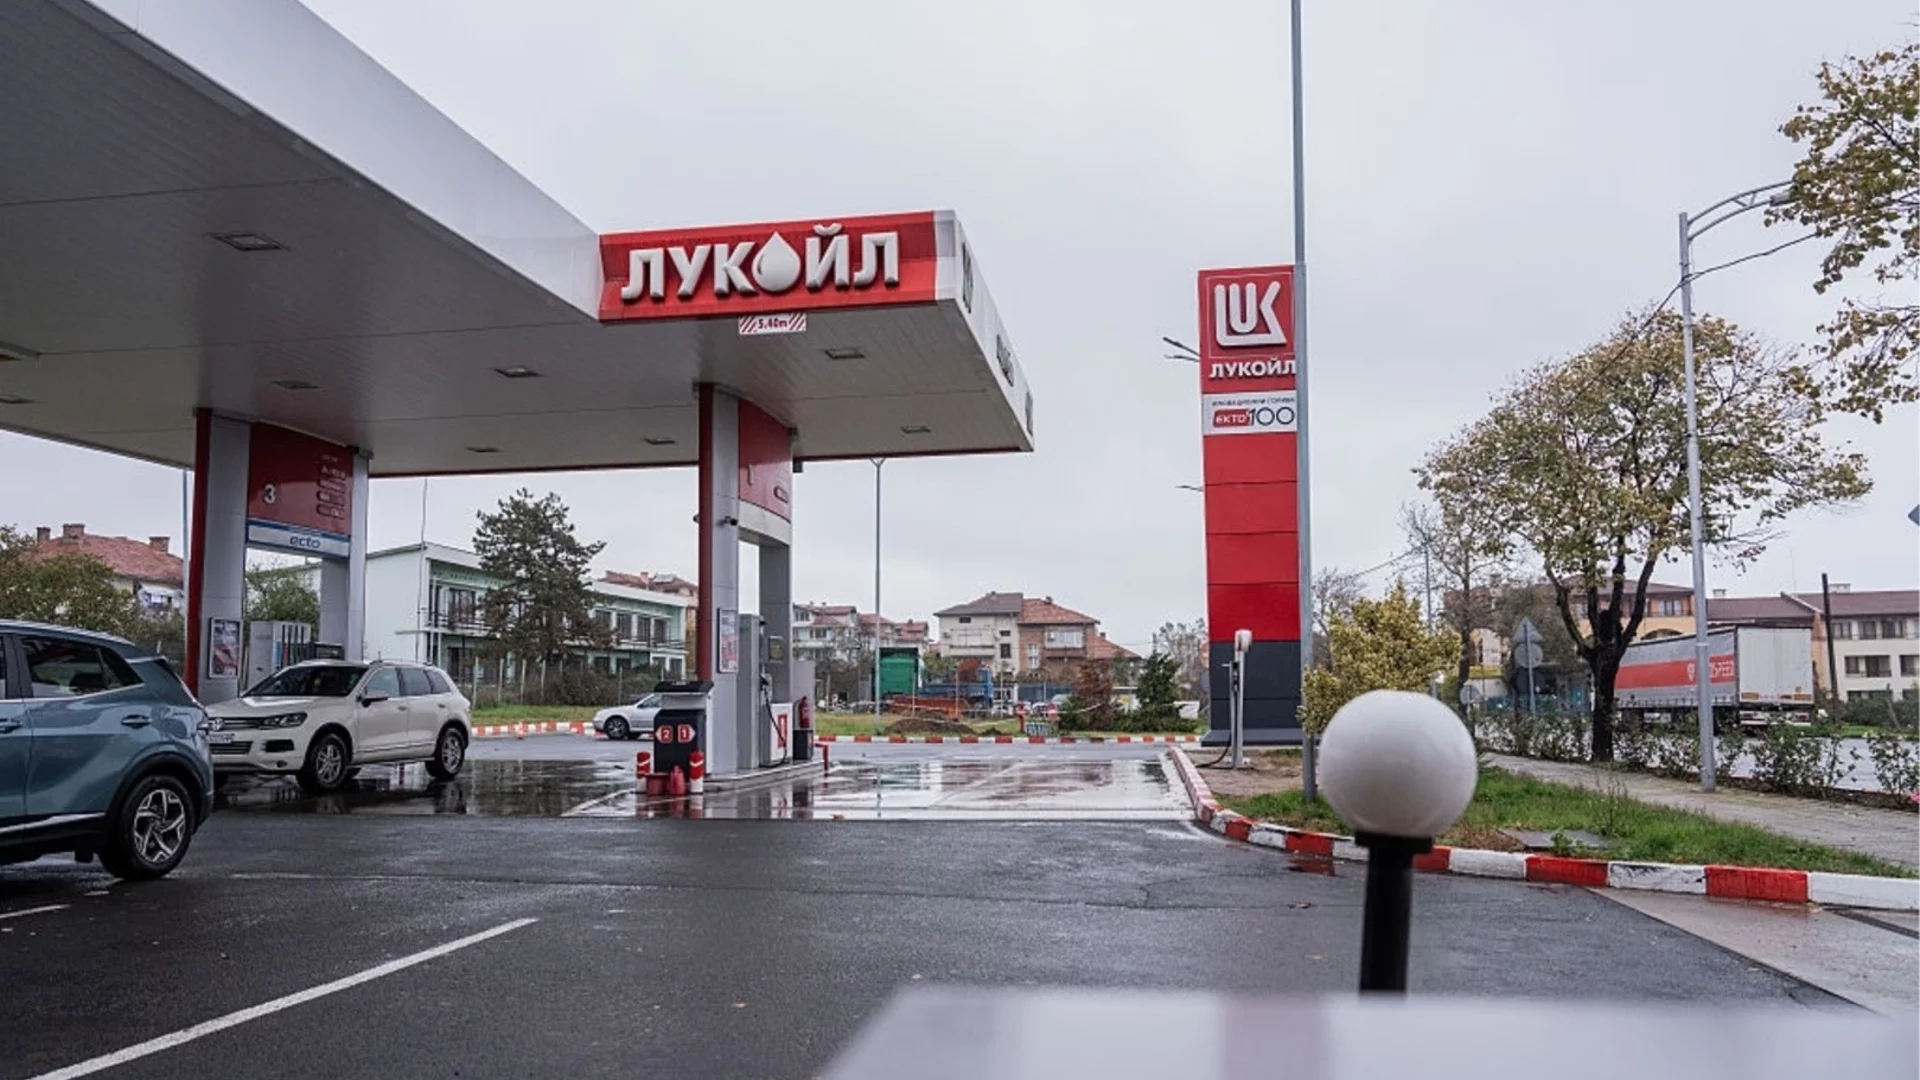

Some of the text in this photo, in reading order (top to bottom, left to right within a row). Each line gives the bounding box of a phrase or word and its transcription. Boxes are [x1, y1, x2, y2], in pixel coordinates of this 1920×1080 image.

[1209, 357, 1296, 378] ЛУКОЙЛ
[1249, 406, 1296, 426] 100
[264, 483, 276, 504] 3
[662, 728, 670, 739] 2
[681, 727, 687, 739] 1
